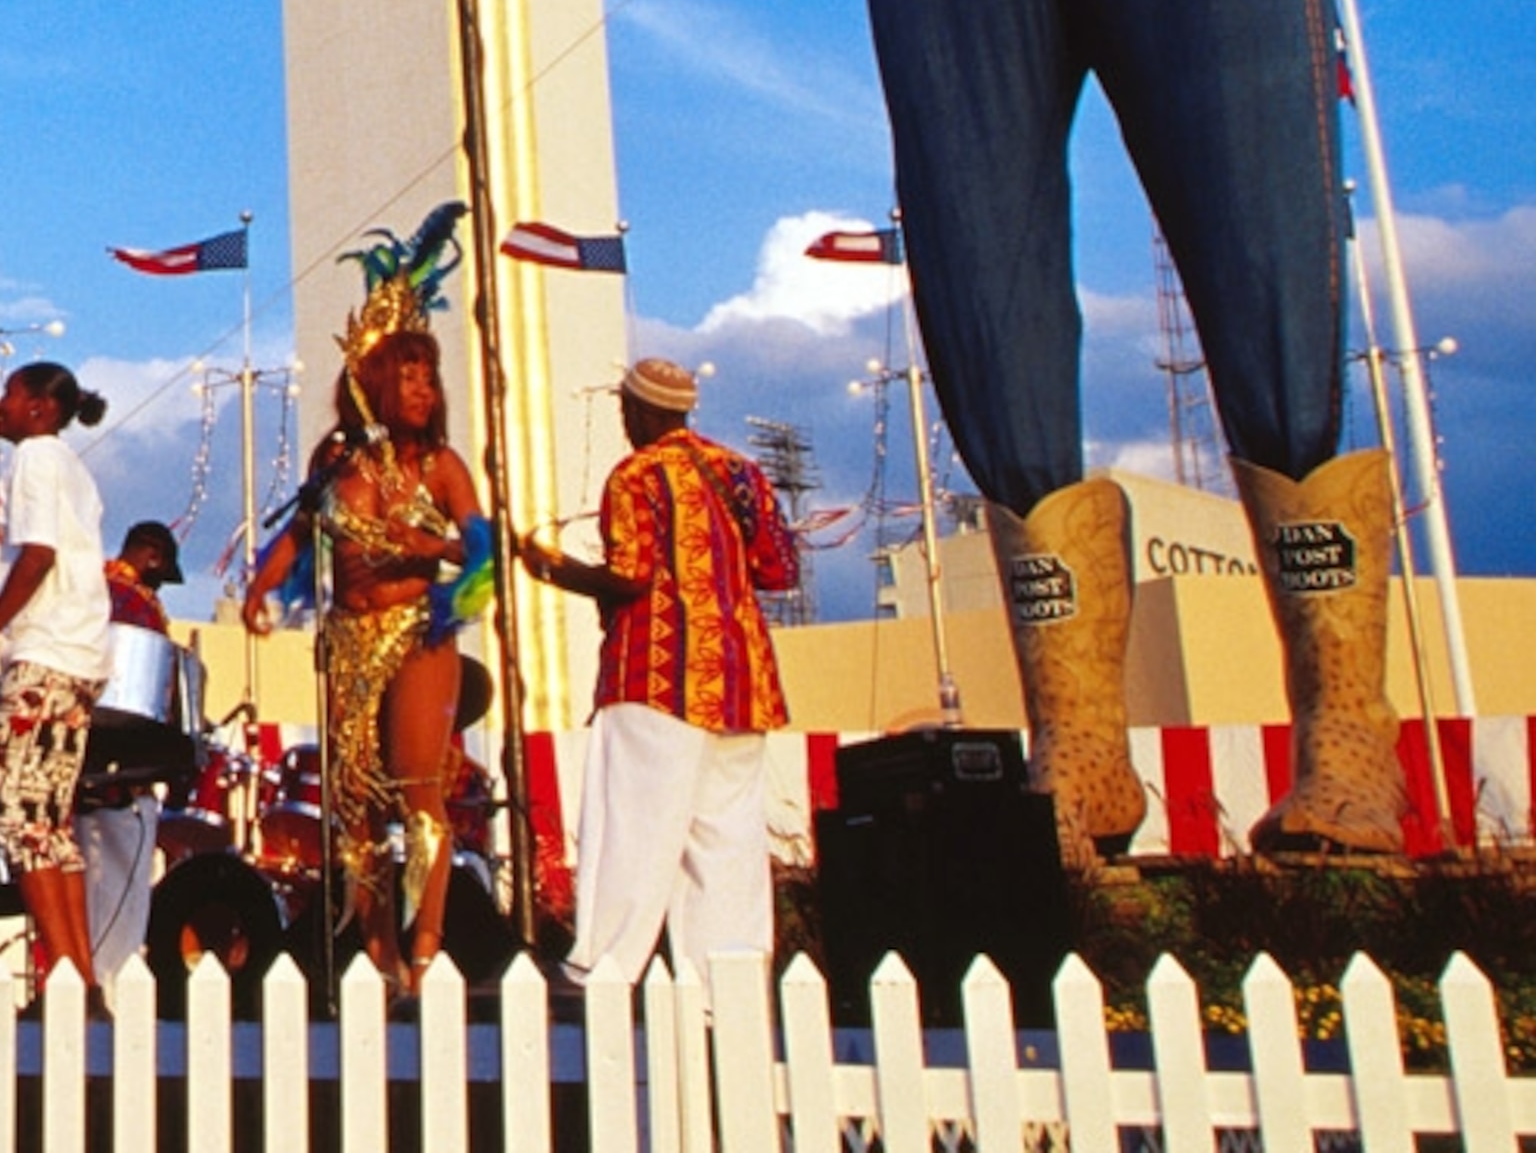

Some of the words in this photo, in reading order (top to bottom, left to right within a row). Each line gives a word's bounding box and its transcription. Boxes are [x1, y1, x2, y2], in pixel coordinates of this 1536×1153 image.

[1283, 524, 1334, 544] DAN
[1282, 544, 1343, 566] POST
[1281, 567, 1355, 589] BOOTS
